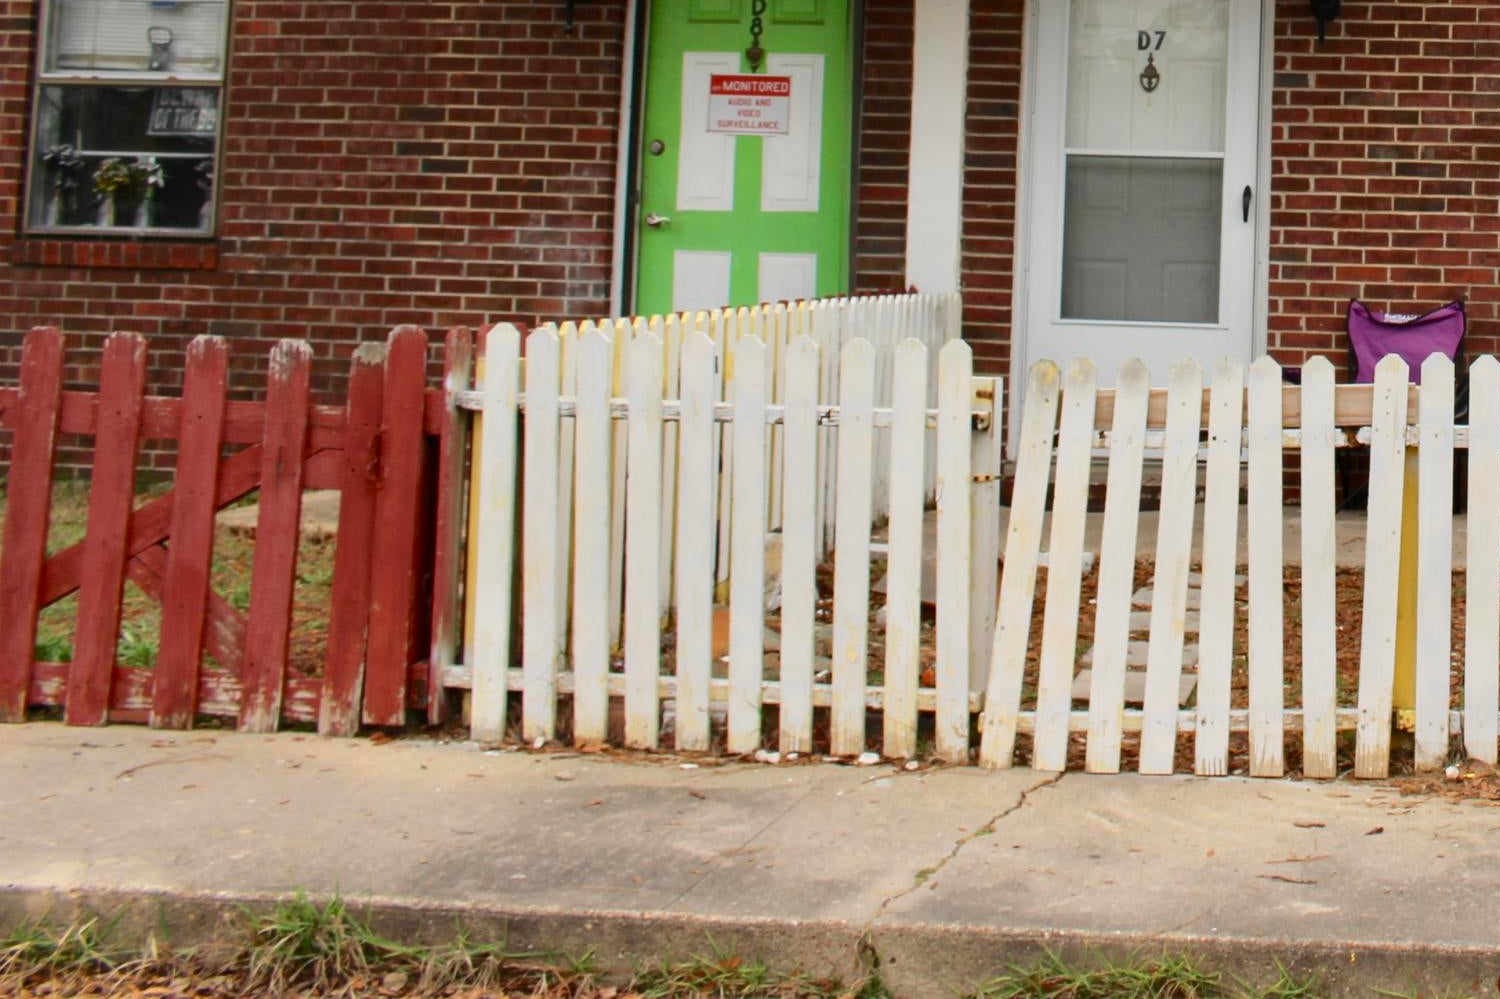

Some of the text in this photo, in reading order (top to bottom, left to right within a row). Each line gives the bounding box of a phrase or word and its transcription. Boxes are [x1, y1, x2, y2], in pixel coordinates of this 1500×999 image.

[1137, 30, 1166, 50] D7
[722, 80, 788, 93] MONITORED
[728, 98, 752, 106] AUDIO
[737, 109, 761, 117] VIDEO
[717, 120, 779, 129] SURVEILLANCE
